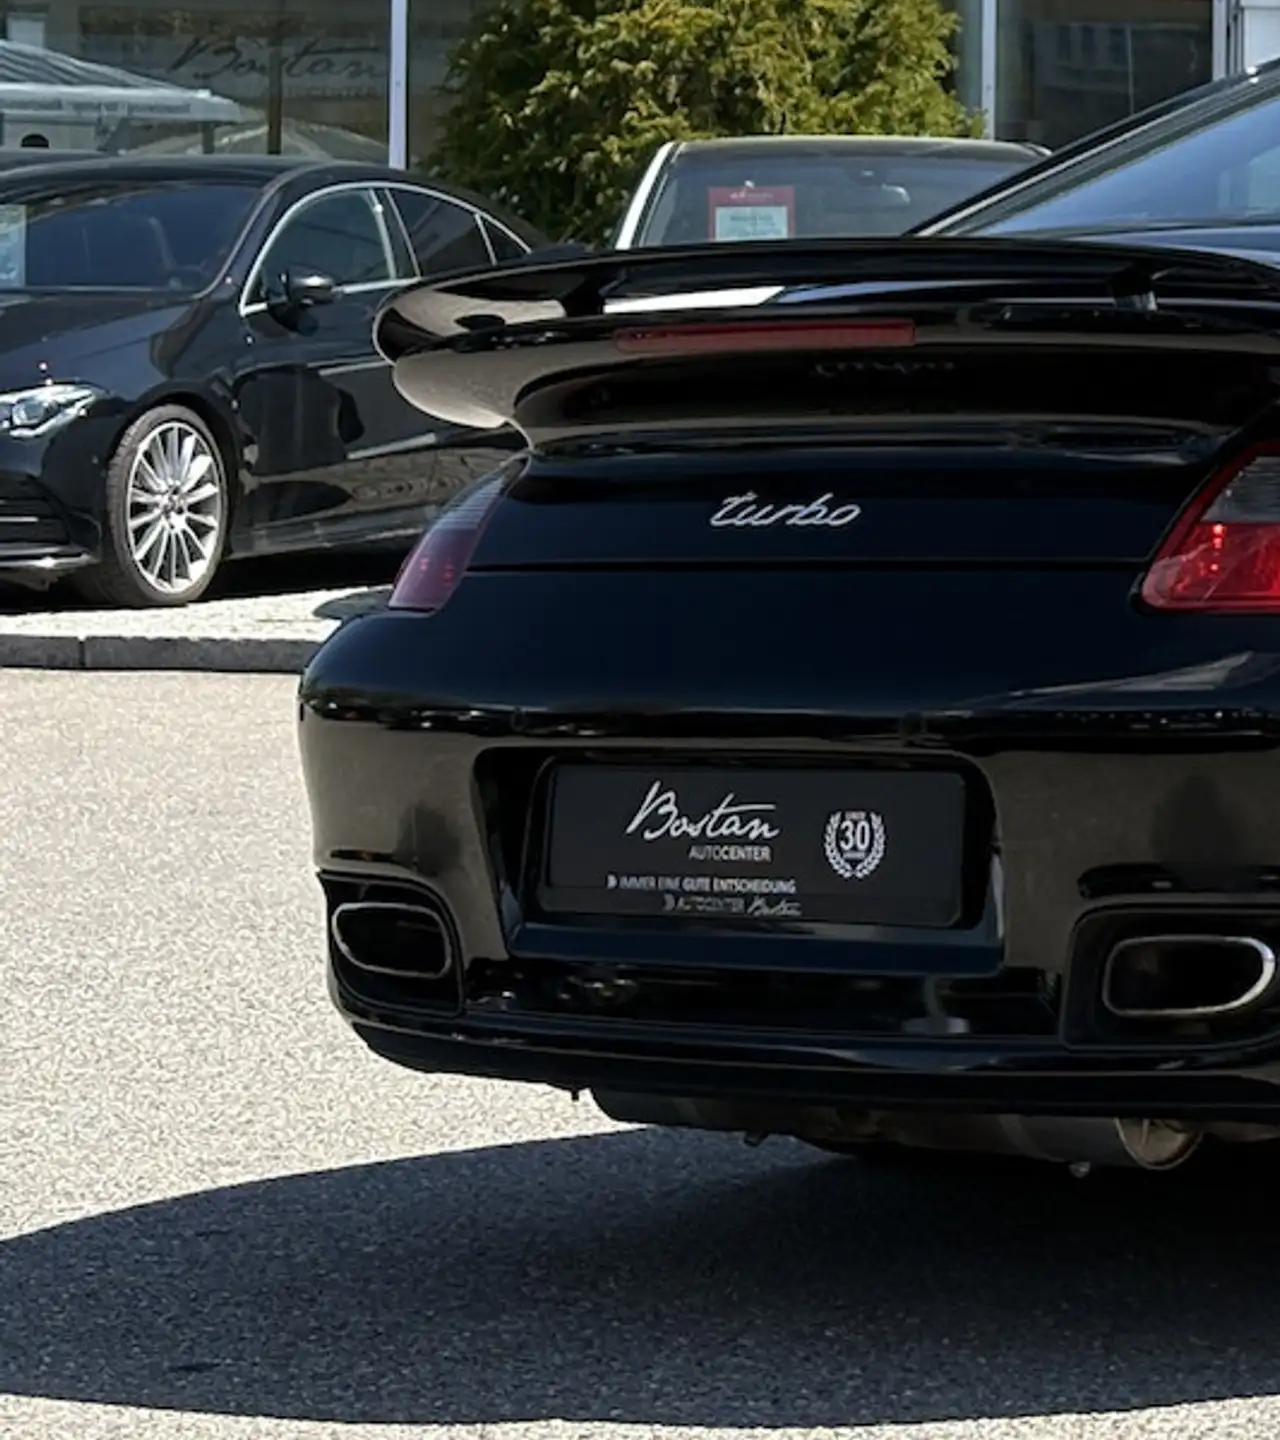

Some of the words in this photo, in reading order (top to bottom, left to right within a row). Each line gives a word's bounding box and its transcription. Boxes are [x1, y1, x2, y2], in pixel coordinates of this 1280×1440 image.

[166, 36, 388, 81] Botan
[709, 491, 861, 527] turbo
[623, 779, 781, 841] Bostan
[839, 820, 870, 851] 30
[688, 844, 772, 863] AUTOCENTER
[682, 877, 712, 893] GUTE
[713, 877, 798, 895] ENTSCHEIDUNG
